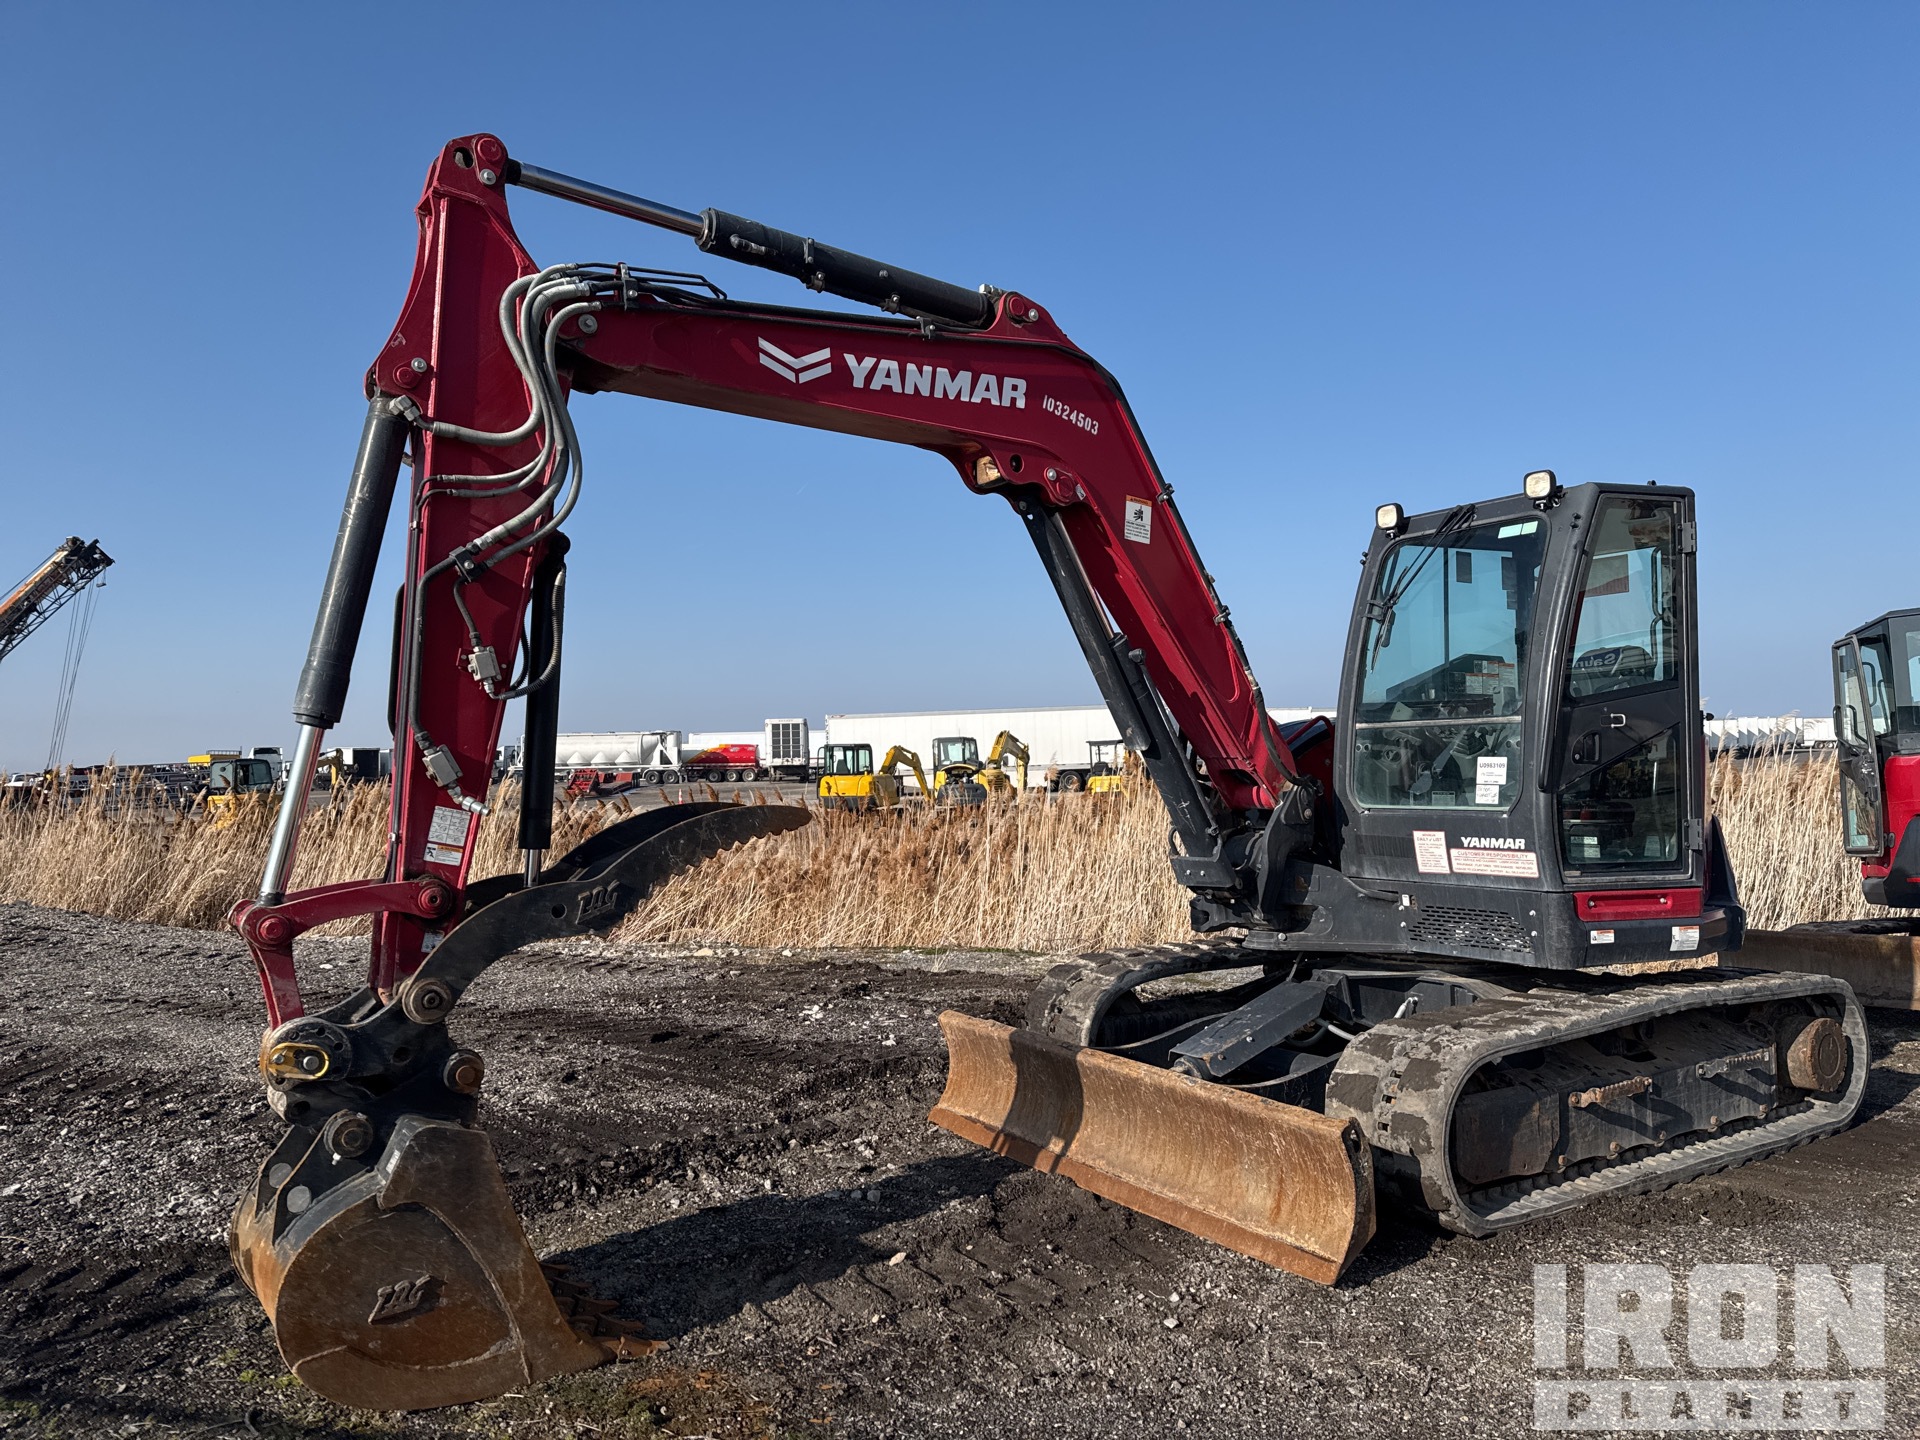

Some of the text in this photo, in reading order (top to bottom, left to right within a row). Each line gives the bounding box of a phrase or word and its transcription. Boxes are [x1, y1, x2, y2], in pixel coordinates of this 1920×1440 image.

[843, 353, 1027, 409] YANMAR
[1043, 394, 1099, 435] 10324503
[1461, 837, 1526, 849] YANMAR
